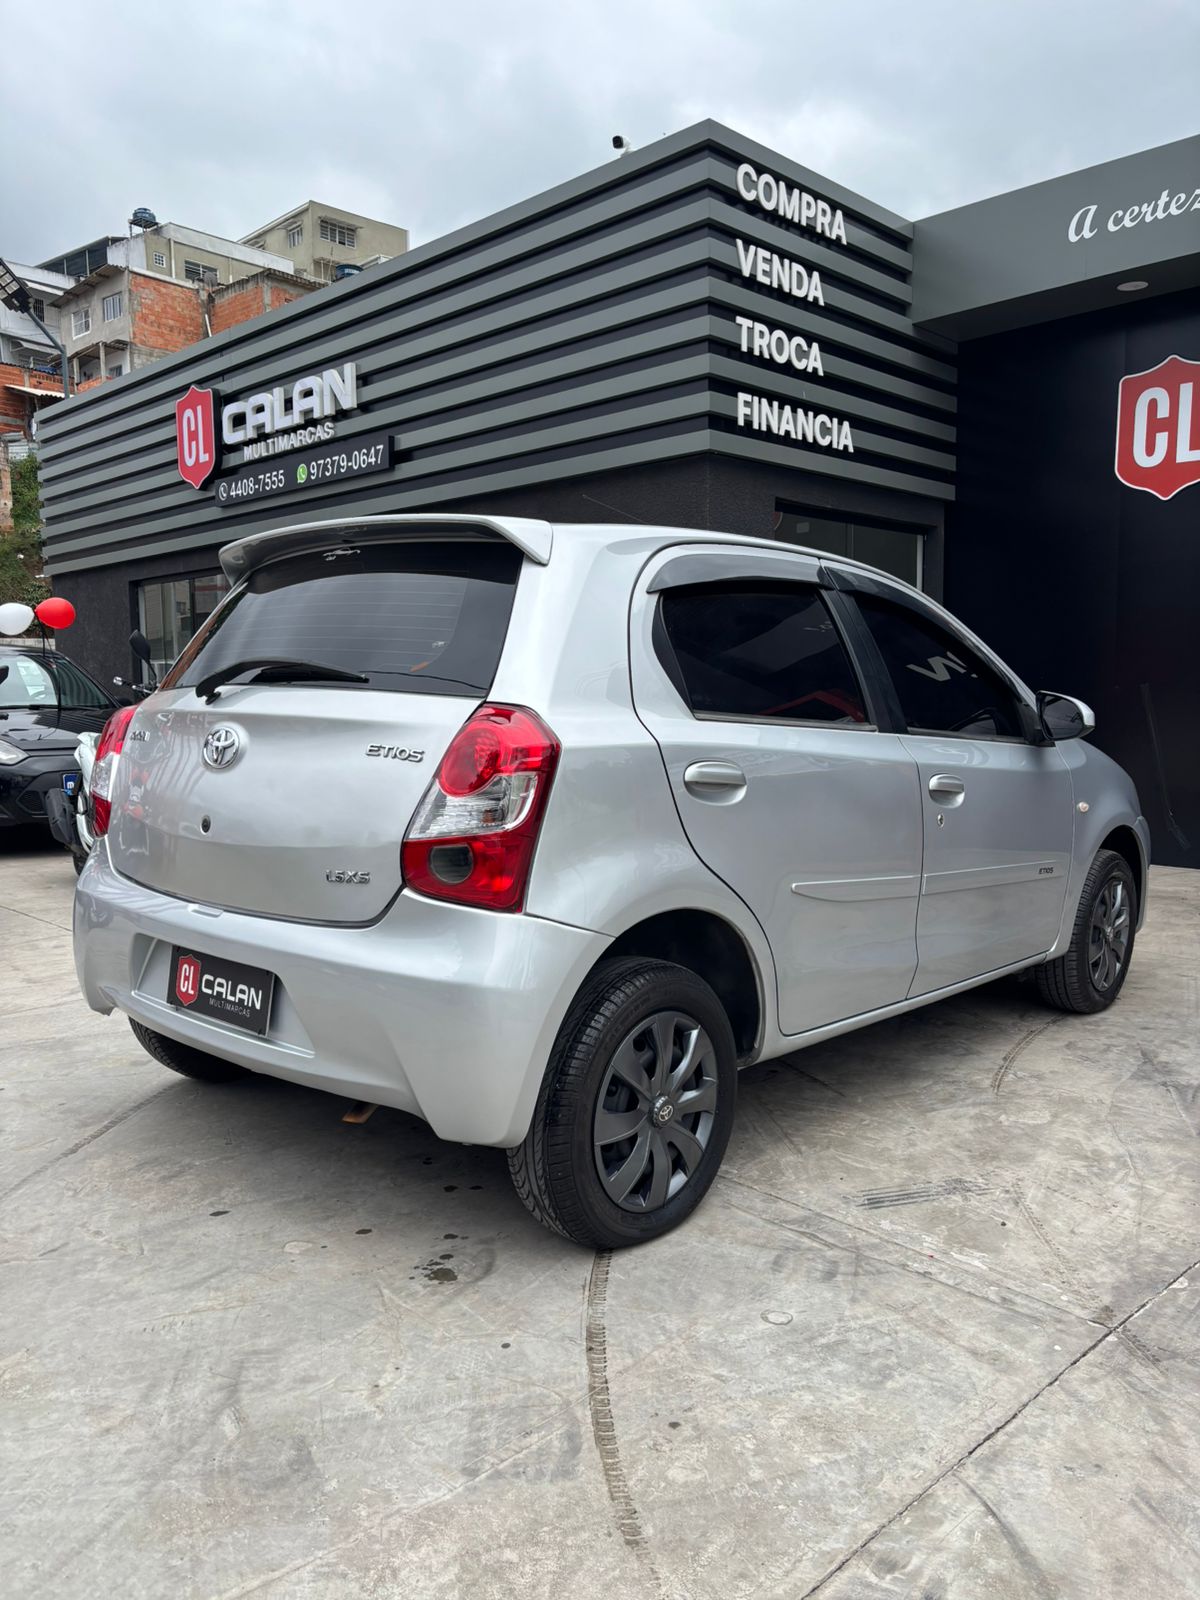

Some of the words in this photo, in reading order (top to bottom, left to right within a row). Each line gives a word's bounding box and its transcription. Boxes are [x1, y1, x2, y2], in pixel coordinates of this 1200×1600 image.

[737, 163, 847, 245] COMPRA
[1068, 204, 1098, 242] A
[736, 238, 825, 306] VENDA
[736, 315, 824, 376] TROCA
[222, 362, 357, 445] CALAN
[737, 391, 854, 453] FINANCIA
[182, 404, 209, 467] CL
[243, 421, 335, 461] MULTIMARCAS
[1132, 381, 1200, 468] CL
[309, 444, 384, 480] 97379-0647
[229, 469, 285, 498] 4408-7555
[366, 742, 425, 763] ETIOS
[180, 963, 195, 995] CL
[201, 973, 262, 1010] CALAN
[208, 997, 251, 1018] MULTIMARCAS
